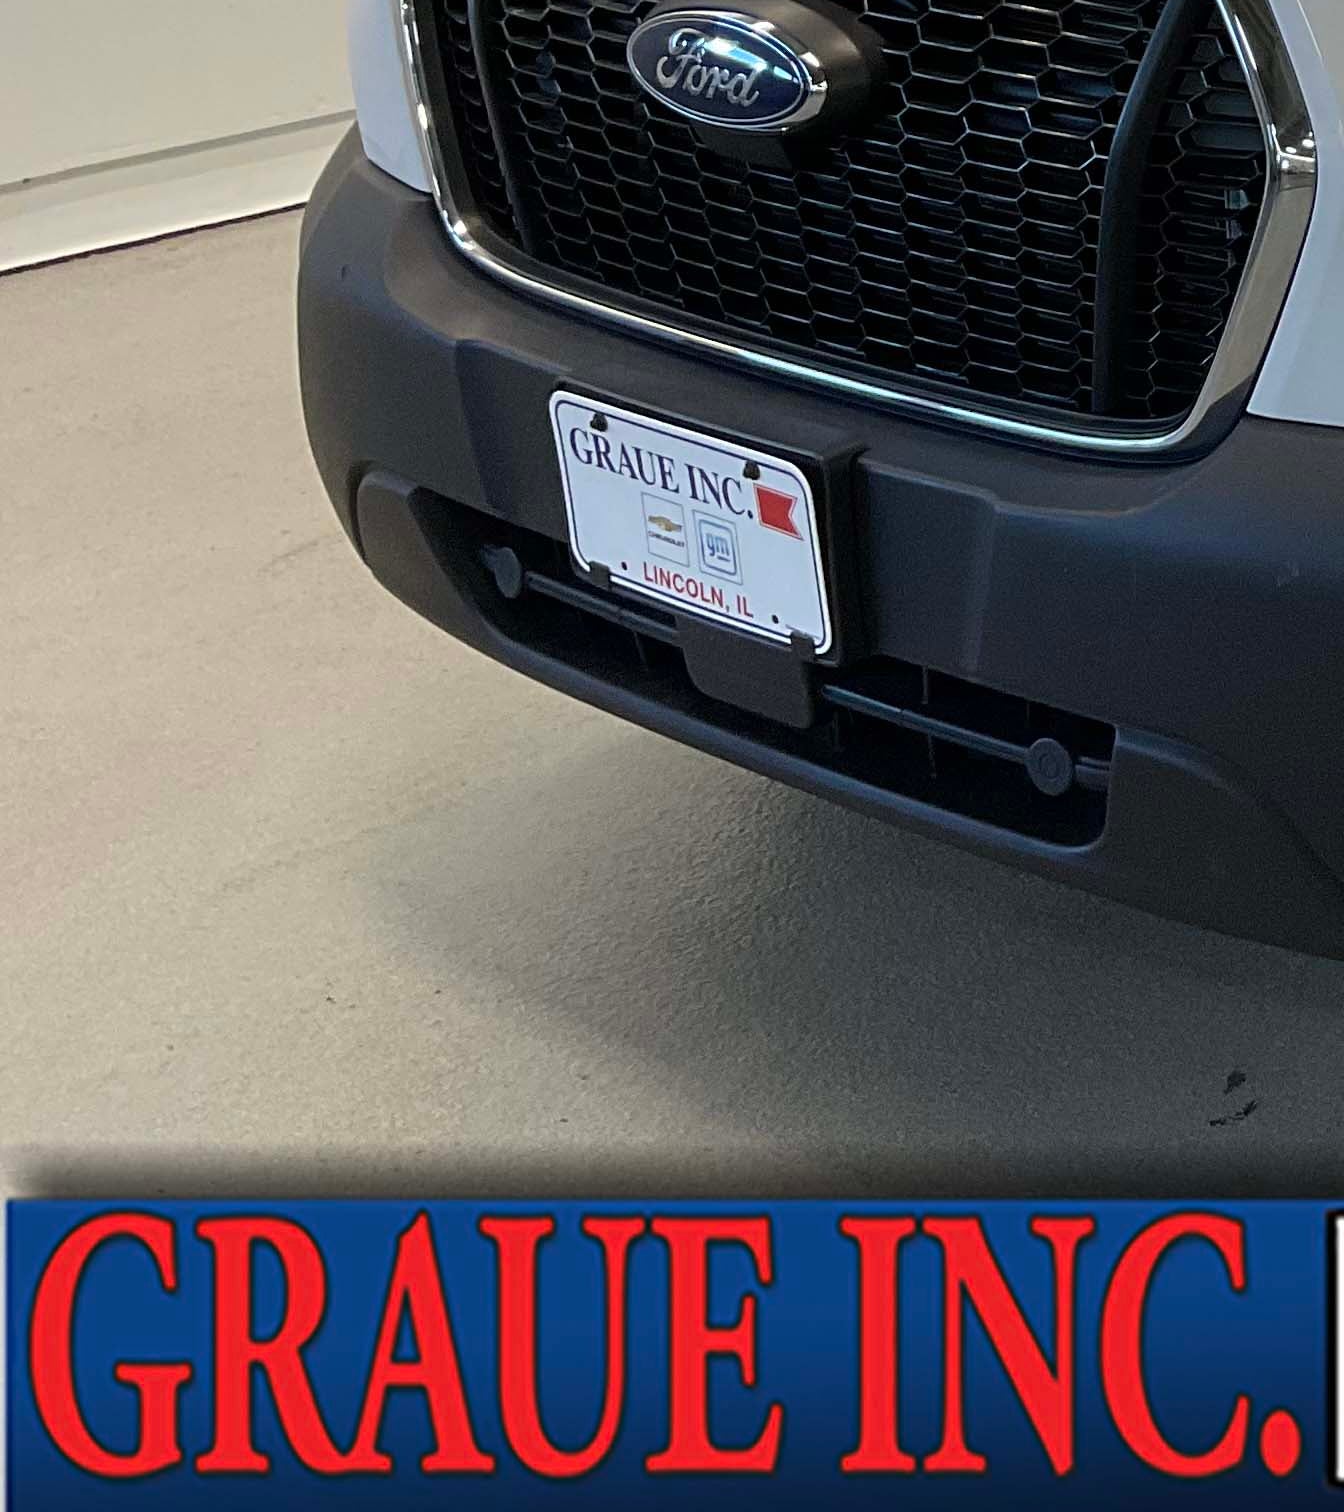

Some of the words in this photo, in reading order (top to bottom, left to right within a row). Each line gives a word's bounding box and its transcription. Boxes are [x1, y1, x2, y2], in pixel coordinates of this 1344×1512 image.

[655, 26, 760, 109] Ford
[569, 426, 681, 494] GRAUE
[684, 462, 754, 520] INC.
[643, 562, 731, 614] LINCOLN,
[736, 594, 754, 618] IL
